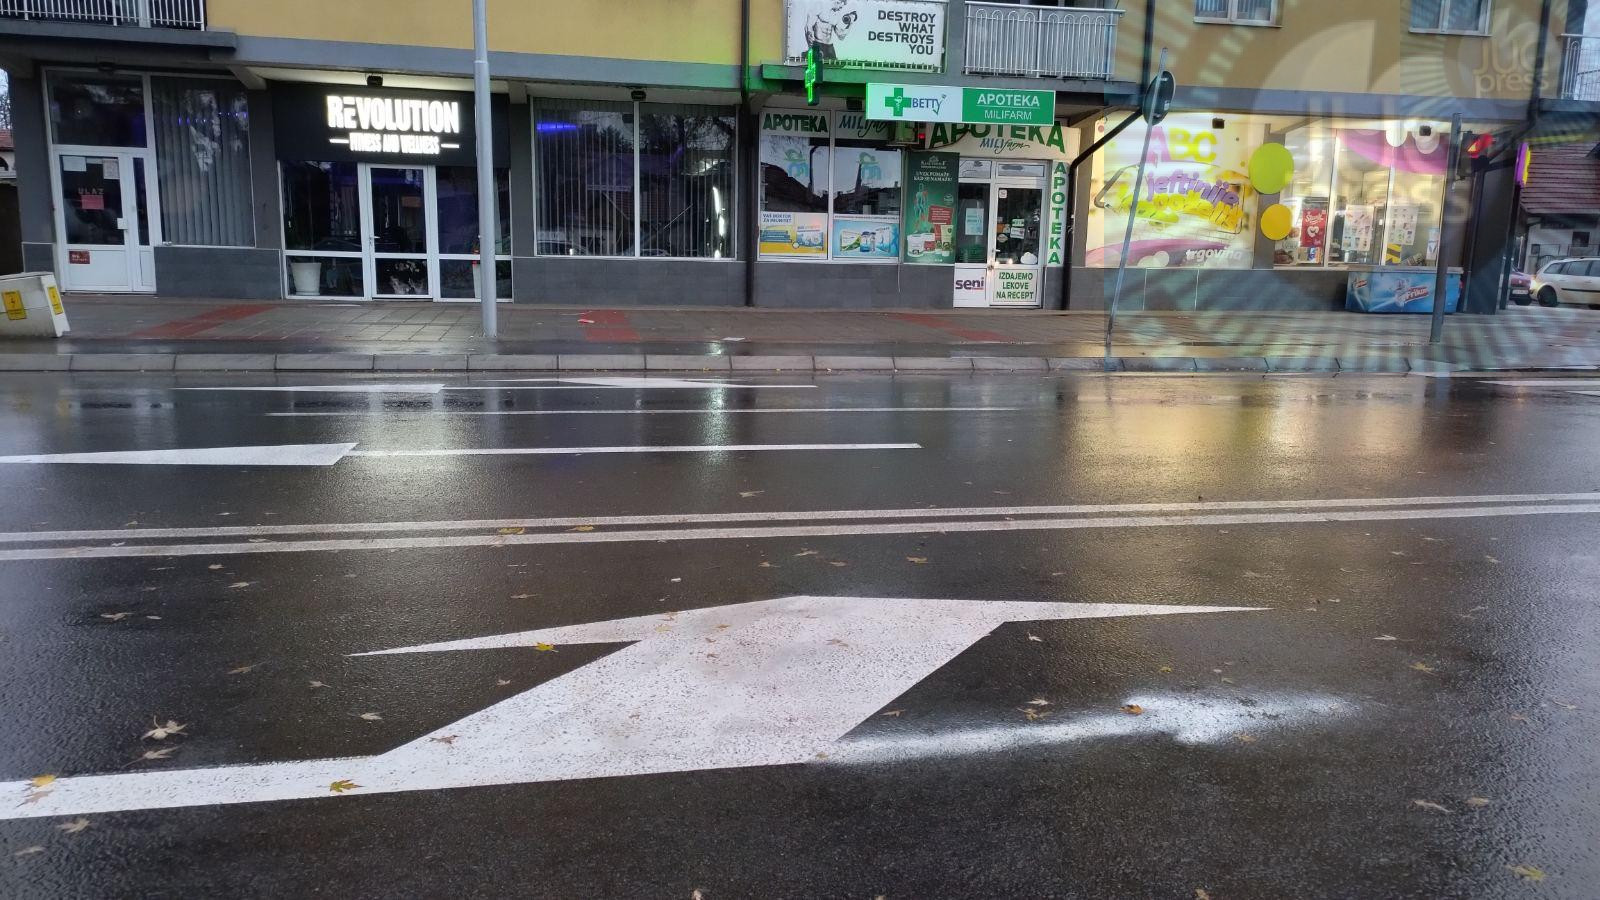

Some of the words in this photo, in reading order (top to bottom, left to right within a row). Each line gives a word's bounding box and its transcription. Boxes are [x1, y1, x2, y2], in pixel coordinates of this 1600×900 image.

[877, 10, 936, 23] DESTROY
[898, 22, 936, 34] WHAT
[868, 31, 935, 45] DESTROYS
[909, 44, 934, 55] YOU
[976, 93, 1041, 107] APOTEKA
[326, 95, 460, 134] REVOLUTION
[984, 110, 1032, 121] MILIFARM
[762, 113, 828, 133] APOTEKA
[1146, 126, 1218, 163] ABC
[78, 187, 105, 195] ULAZ
[1047, 161, 1067, 265] APOTEKA
[955, 276, 985, 290] seni
[998, 272, 1034, 281] IZDAJEMO
[1002, 281, 1030, 290] LEKOVE
[996, 291, 1007, 300] NA
[1007, 291, 1035, 300] RECEPT
